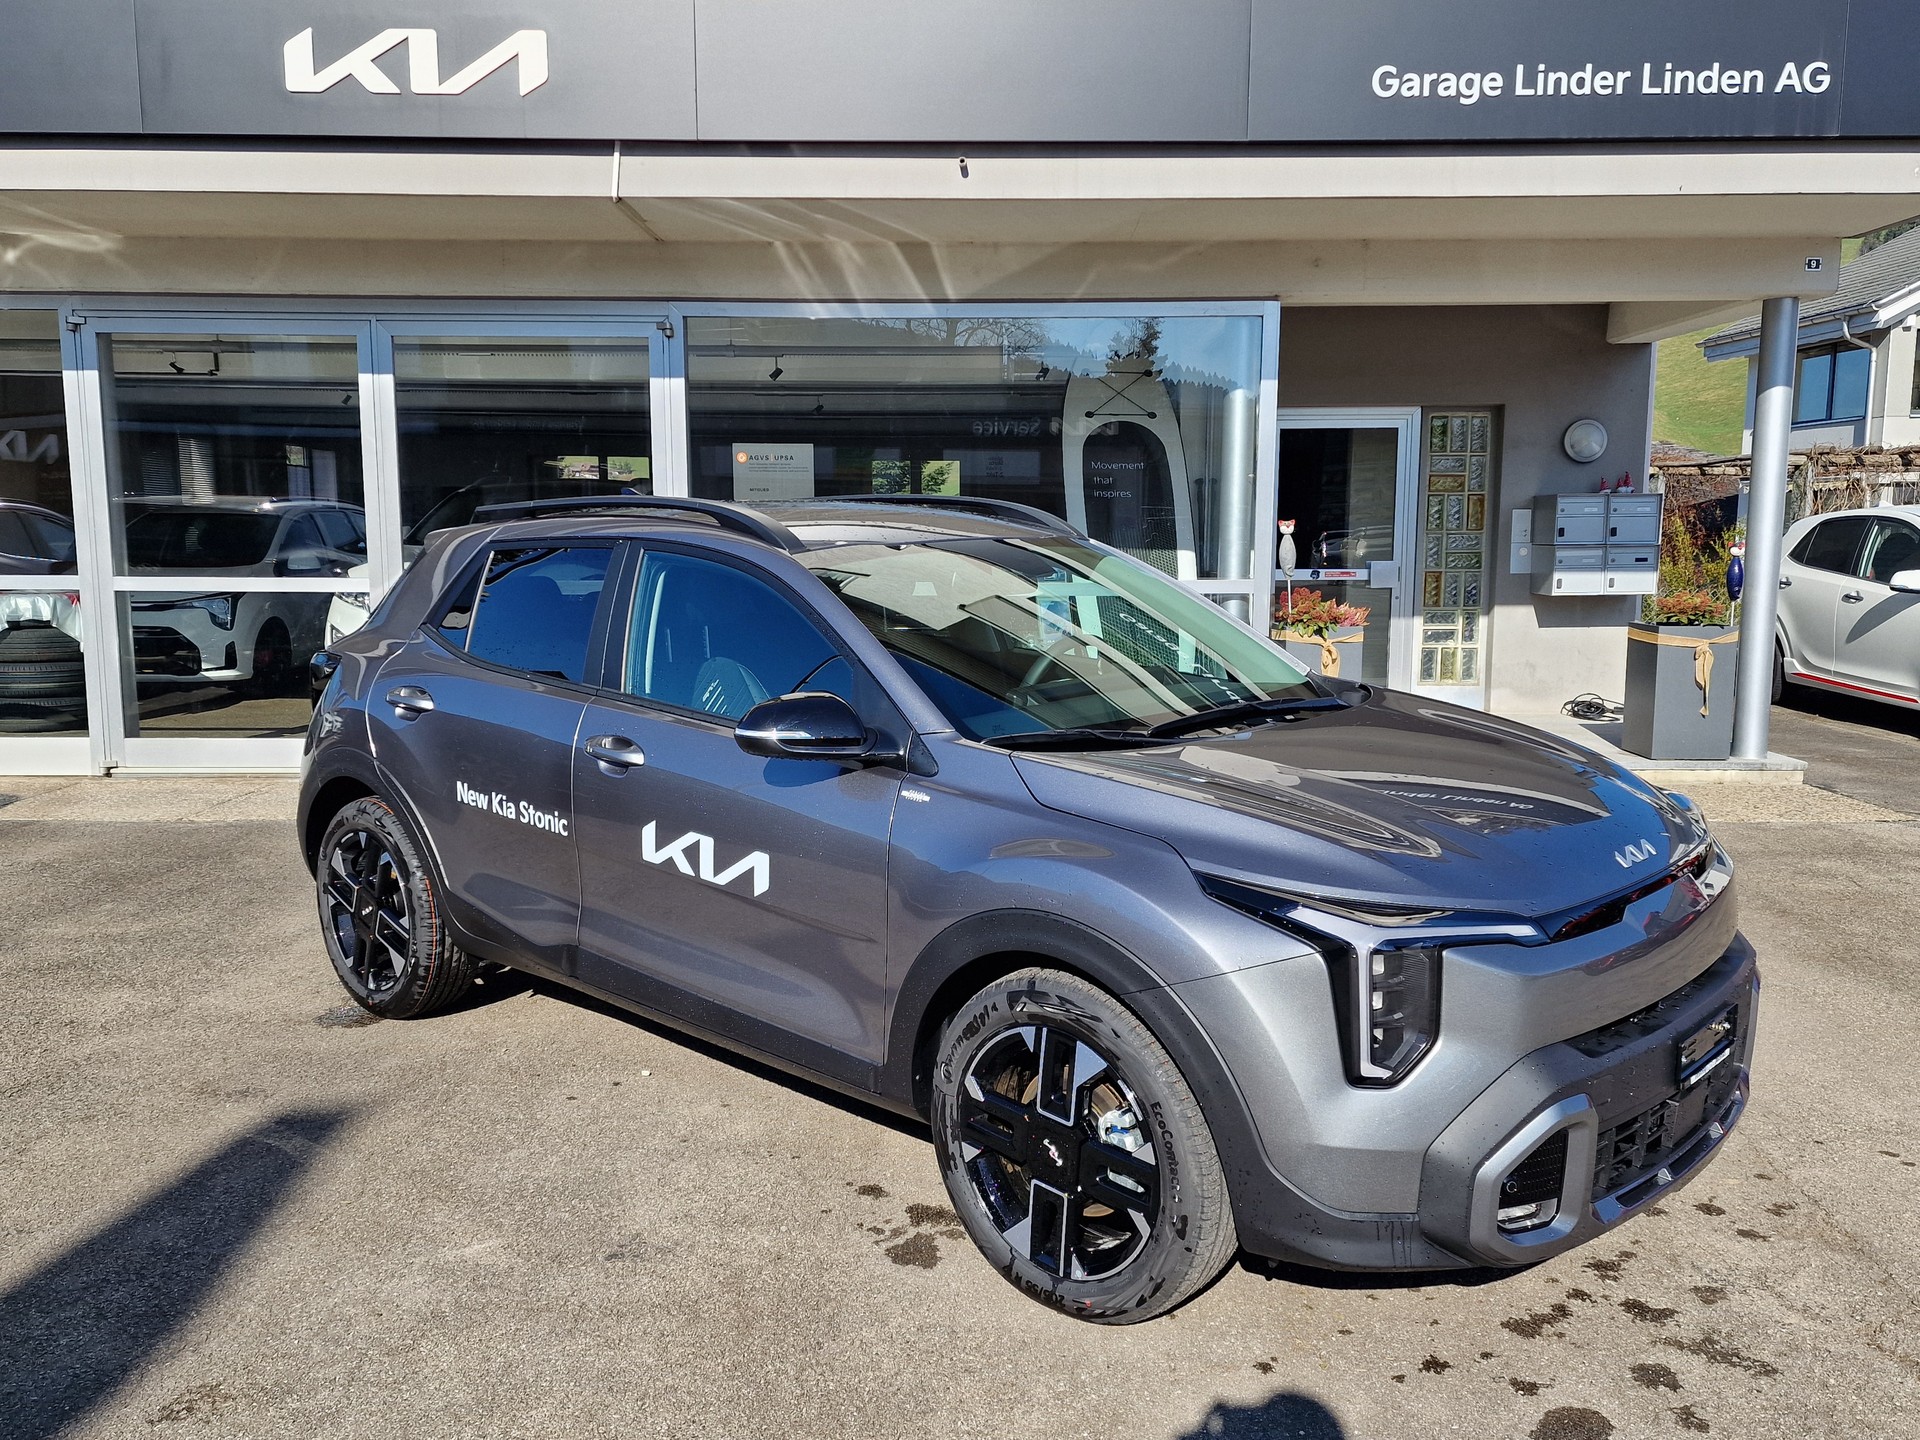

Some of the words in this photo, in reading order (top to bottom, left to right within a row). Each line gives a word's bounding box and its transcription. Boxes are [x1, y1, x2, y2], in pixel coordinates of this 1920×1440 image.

[283, 26, 549, 97] KIA
[1371, 65, 1504, 105] Garage
[1514, 63, 1631, 97] Linder
[1641, 62, 1764, 95] Linden
[1773, 61, 1831, 94] AG
[1810, 259, 1817, 269] 9
[1091, 461, 1145, 470] Movement
[1093, 476, 1113, 484] that
[1093, 490, 1132, 498] inspires
[456, 781, 488, 810] New
[491, 791, 517, 819] Kia
[519, 800, 569, 837] Stonic
[641, 820, 769, 897] KIA
[1614, 838, 1657, 868] KIA
